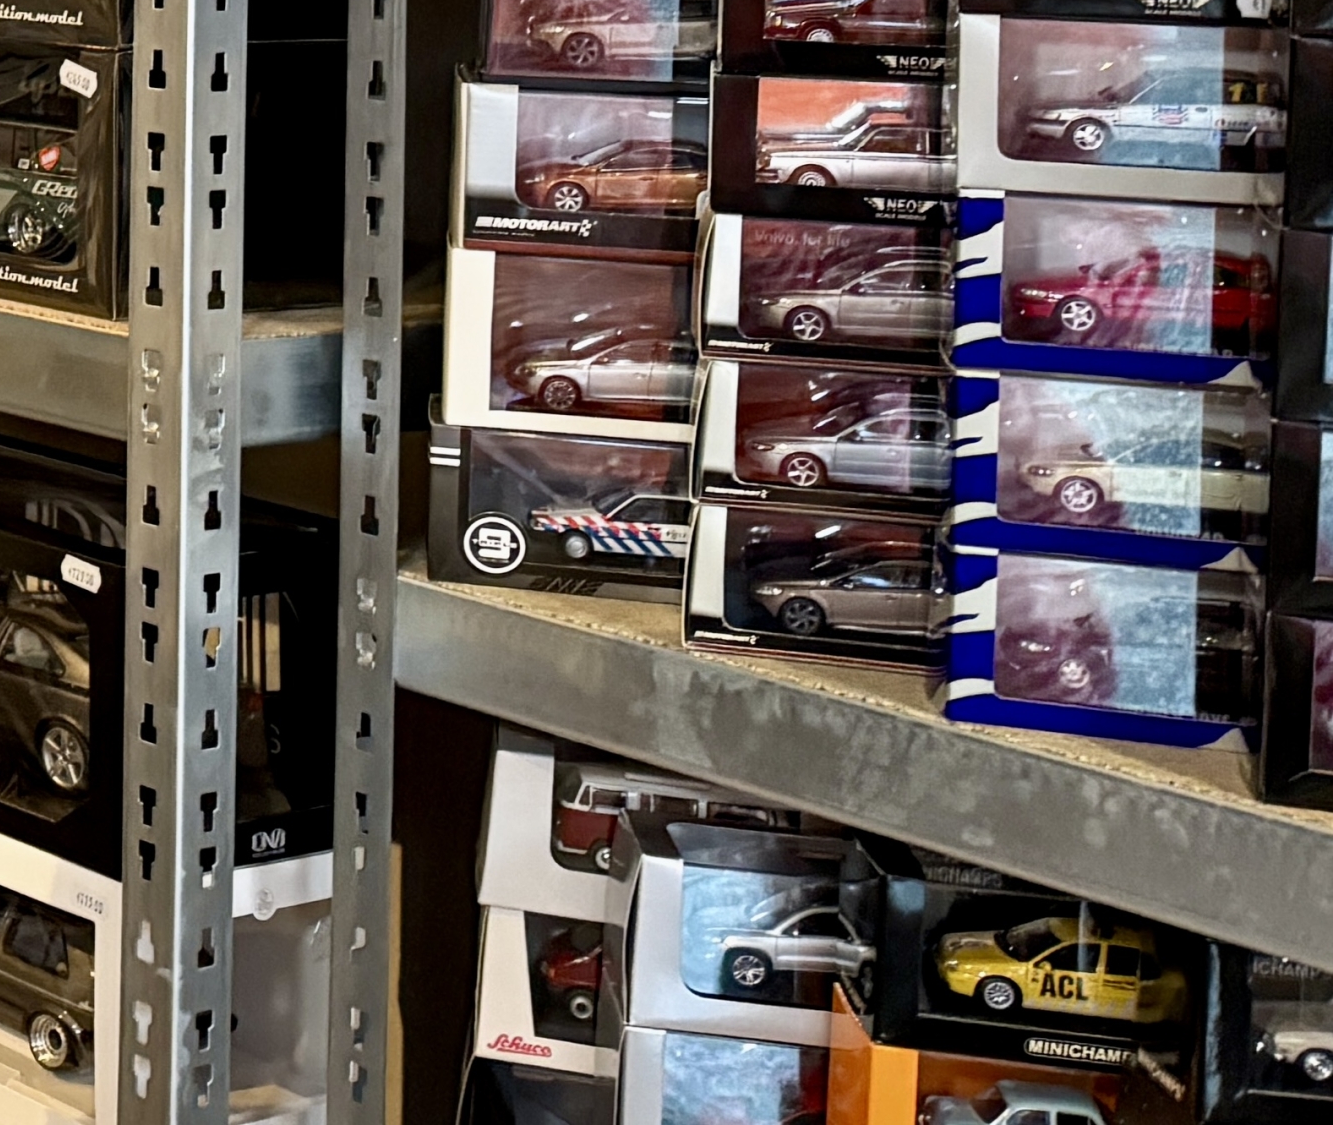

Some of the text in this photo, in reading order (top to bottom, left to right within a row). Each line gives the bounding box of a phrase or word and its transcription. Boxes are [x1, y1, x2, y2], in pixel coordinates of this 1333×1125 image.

[899, 55, 930, 70] NEO
[886, 199, 916, 213] NEO
[491, 217, 579, 233] MOTORART
[1039, 975, 1089, 1001] ACL
[487, 1033, 552, 1057] Schuco
